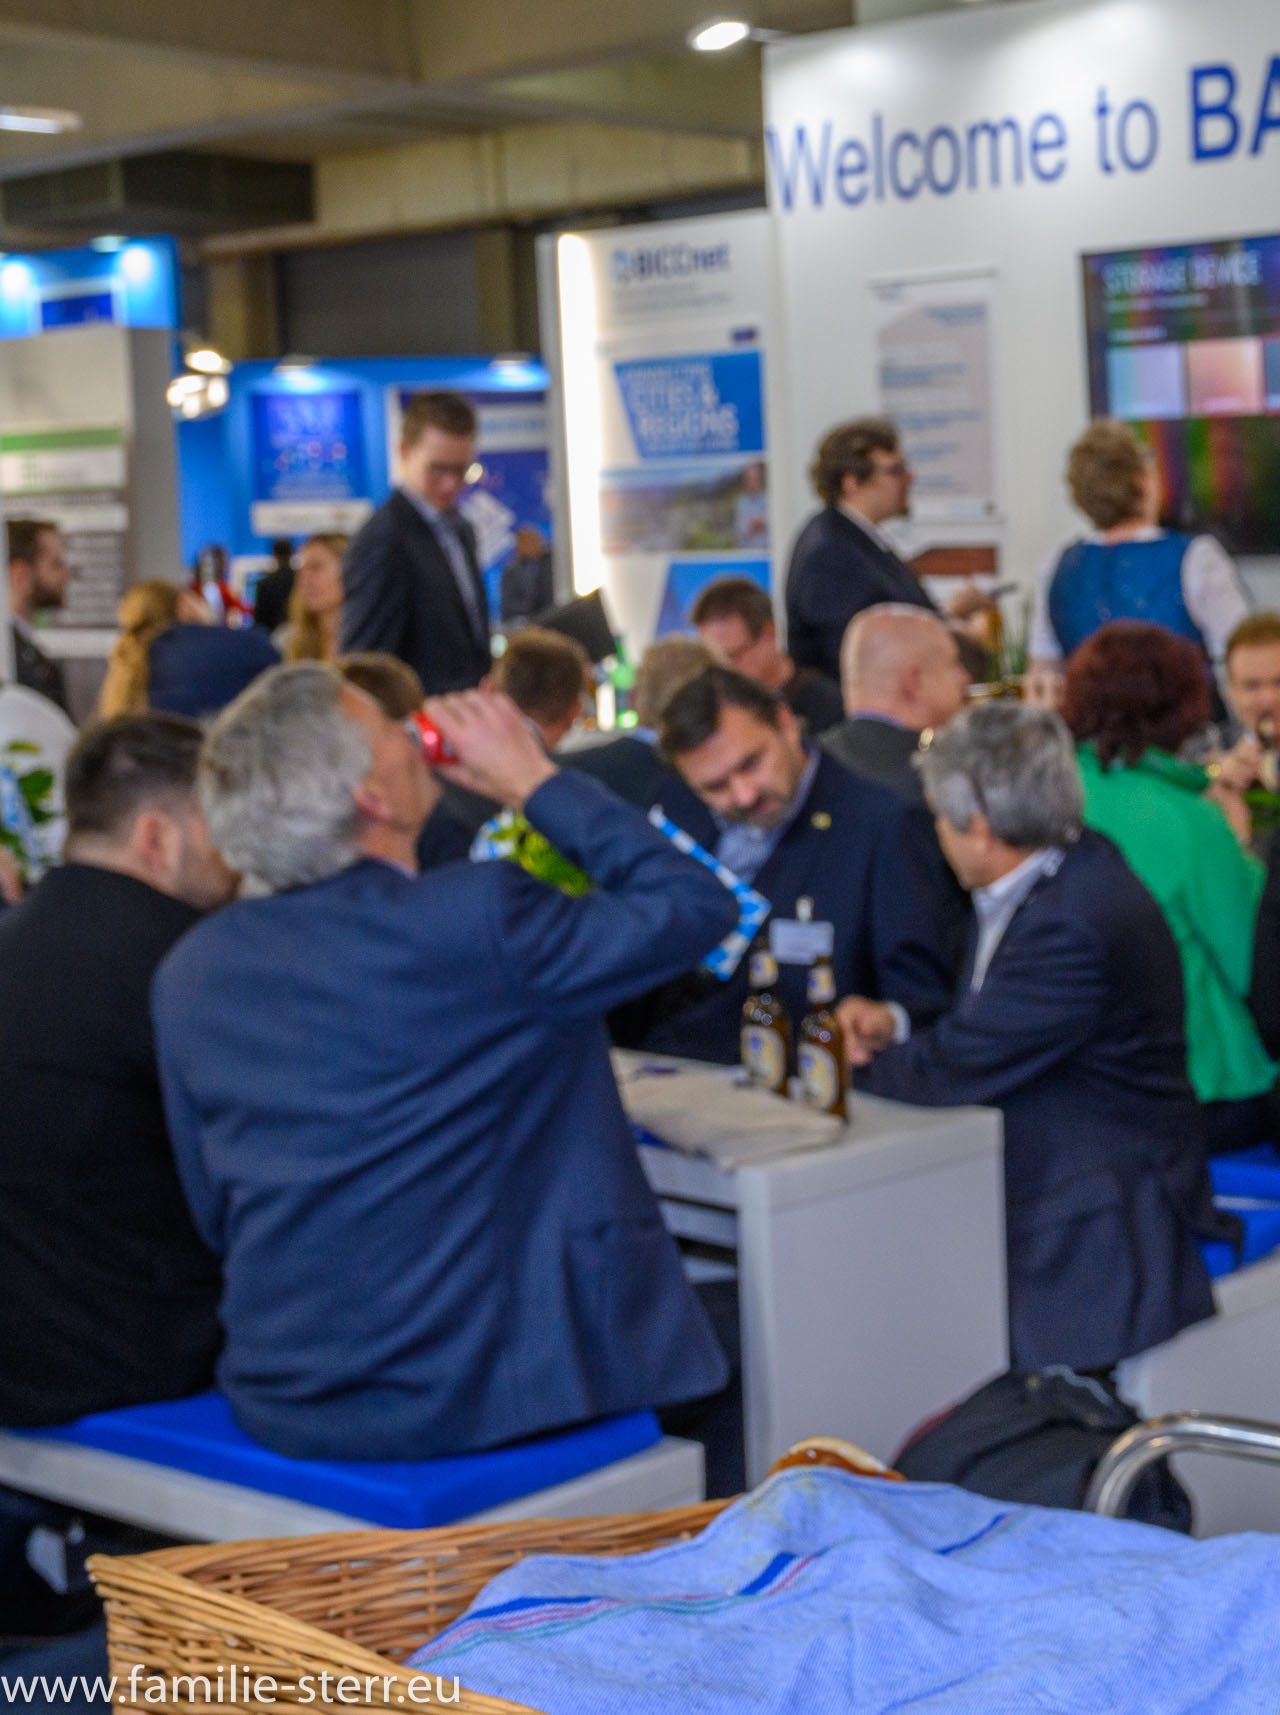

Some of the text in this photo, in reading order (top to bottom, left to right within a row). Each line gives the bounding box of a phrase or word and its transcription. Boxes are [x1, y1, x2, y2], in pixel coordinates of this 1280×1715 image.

[765, 112, 1069, 212] Welcome
[1094, 86, 1160, 175] to
[637, 243, 731, 278] BICCnet
[1102, 248, 1263, 296] STORAGE DEVICE
